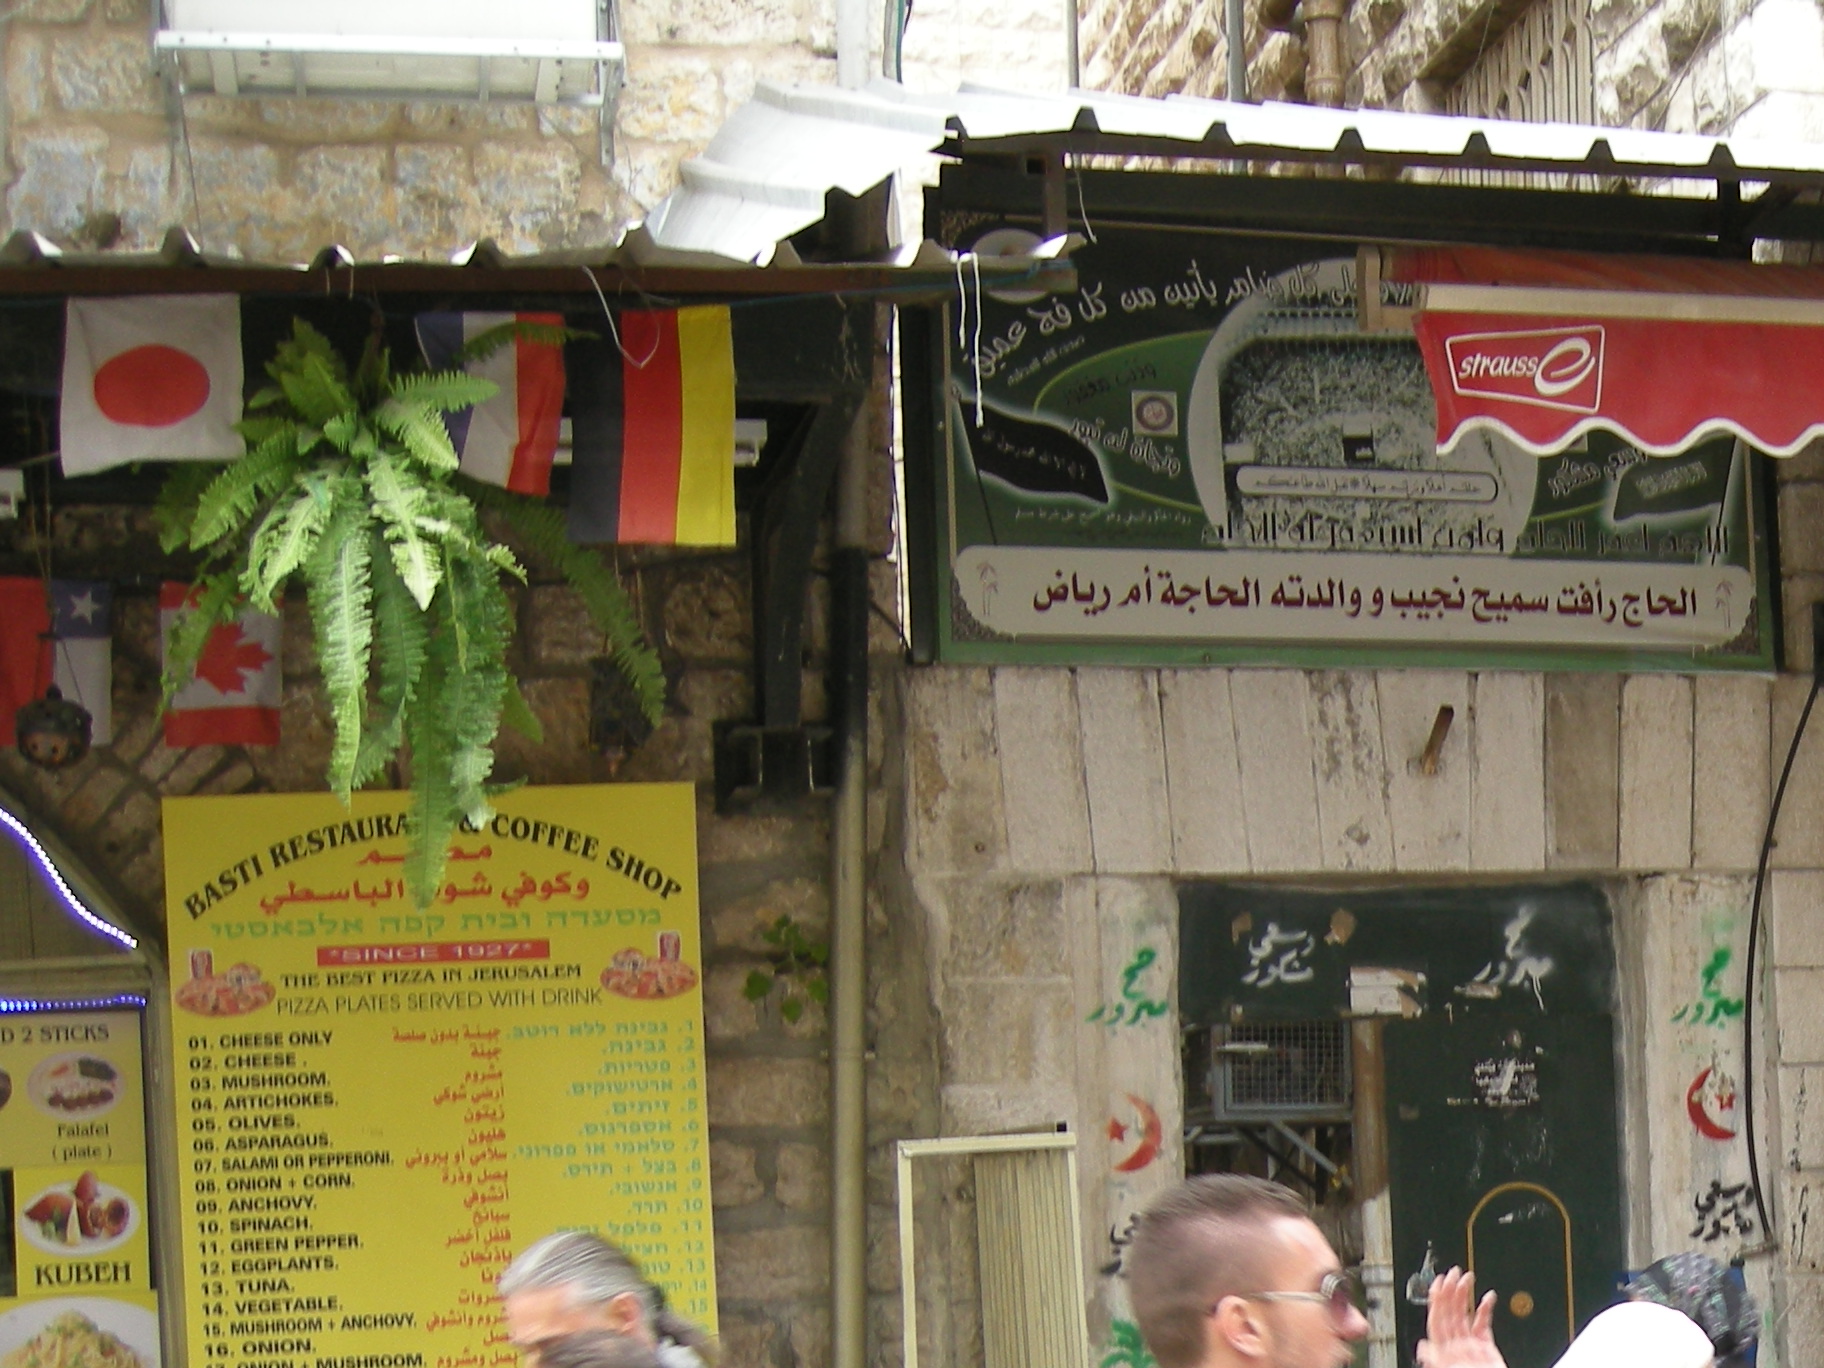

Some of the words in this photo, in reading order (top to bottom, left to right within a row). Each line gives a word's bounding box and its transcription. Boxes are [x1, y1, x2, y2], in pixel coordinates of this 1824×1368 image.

[1458, 353, 1539, 379] strauss
[1033, 569, 1111, 616] رياض
[1117, 565, 1152, 607] أم
[1157, 569, 1261, 614] الحاجة
[1270, 574, 1362, 617] والدته
[1390, 575, 1465, 620] نجيب
[1471, 586, 1548, 623] سميح
[1557, 577, 1617, 623] رأفت
[1622, 586, 1697, 627] الحاج
[185, 854, 263, 920] BASTI
[491, 814, 599, 861] COFFEE
[606, 846, 681, 900] SHOP
[260, 878, 405, 916] الباسطي
[501, 870, 589, 908] وكوفي
[546, 907, 661, 928] מסעדה
[281, 973, 320, 988] THE
[327, 972, 375, 987] BEST
[382, 969, 435, 986] PIZZA
[442, 968, 462, 983] IN
[468, 964, 581, 983] JERUSALEM
[277, 997, 329, 1017] PIZZA
[336, 994, 400, 1016] PLATES
[407, 992, 482, 1010] SERVED
[488, 990, 536, 1007] WITH
[543, 988, 602, 1006] DRINK
[22, 1027, 32, 1043] 2
[40, 1023, 109, 1042] STICKS
[189, 1036, 214, 1050] 01.
[220, 1032, 283, 1048] CHEESE
[289, 1031, 332, 1045] ONLY
[190, 1057, 218, 1070] 02.
[224, 1053, 296, 1069] CHEESE
[190, 1077, 215, 1091] 03.
[222, 1073, 331, 1089] MUSHROOM.
[191, 1098, 217, 1111] 04.
[224, 1093, 338, 1110] ARTICHOKES.
[58, 1123, 109, 1137] Falafel
[192, 1118, 221, 1131] 05.
[229, 1115, 300, 1130] OLIVES.
[193, 1139, 219, 1152] 06.
[226, 1134, 333, 1150] ASPARAGUS.
[194, 1160, 217, 1173] 07.
[222, 1156, 278, 1171] SALAMI
[284, 1155, 304, 1169] OR
[309, 1151, 394, 1168] PEPPERONI.
[196, 1180, 220, 1193] 08.
[226, 1177, 281, 1192] ONION
[303, 1174, 355, 1188] CORN.
[196, 1200, 222, 1213] 09.
[228, 1196, 317, 1212] ANCHOVY.
[198, 1222, 223, 1235] 10.
[230, 1217, 313, 1233] SPINACH.
[200, 1242, 224, 1255] 11.
[231, 1237, 288, 1253] GREEN
[295, 1235, 364, 1250] PEPPER.
[34, 1260, 131, 1287] KUBEH
[201, 1262, 225, 1276] 12.
[232, 1256, 339, 1273] EGGPLANTS.
[202, 1282, 229, 1296] 13.
[236, 1279, 294, 1294] TUNA.
[202, 1302, 229, 1317] 14.
[235, 1296, 343, 1315] VEGETABLE.
[204, 1323, 225, 1337] 15.
[231, 1318, 322, 1336] MUSHROOM
[341, 1313, 417, 1330] ANCHOVY.
[205, 1344, 234, 1357] 16.
[242, 1339, 316, 1355] ONION.
